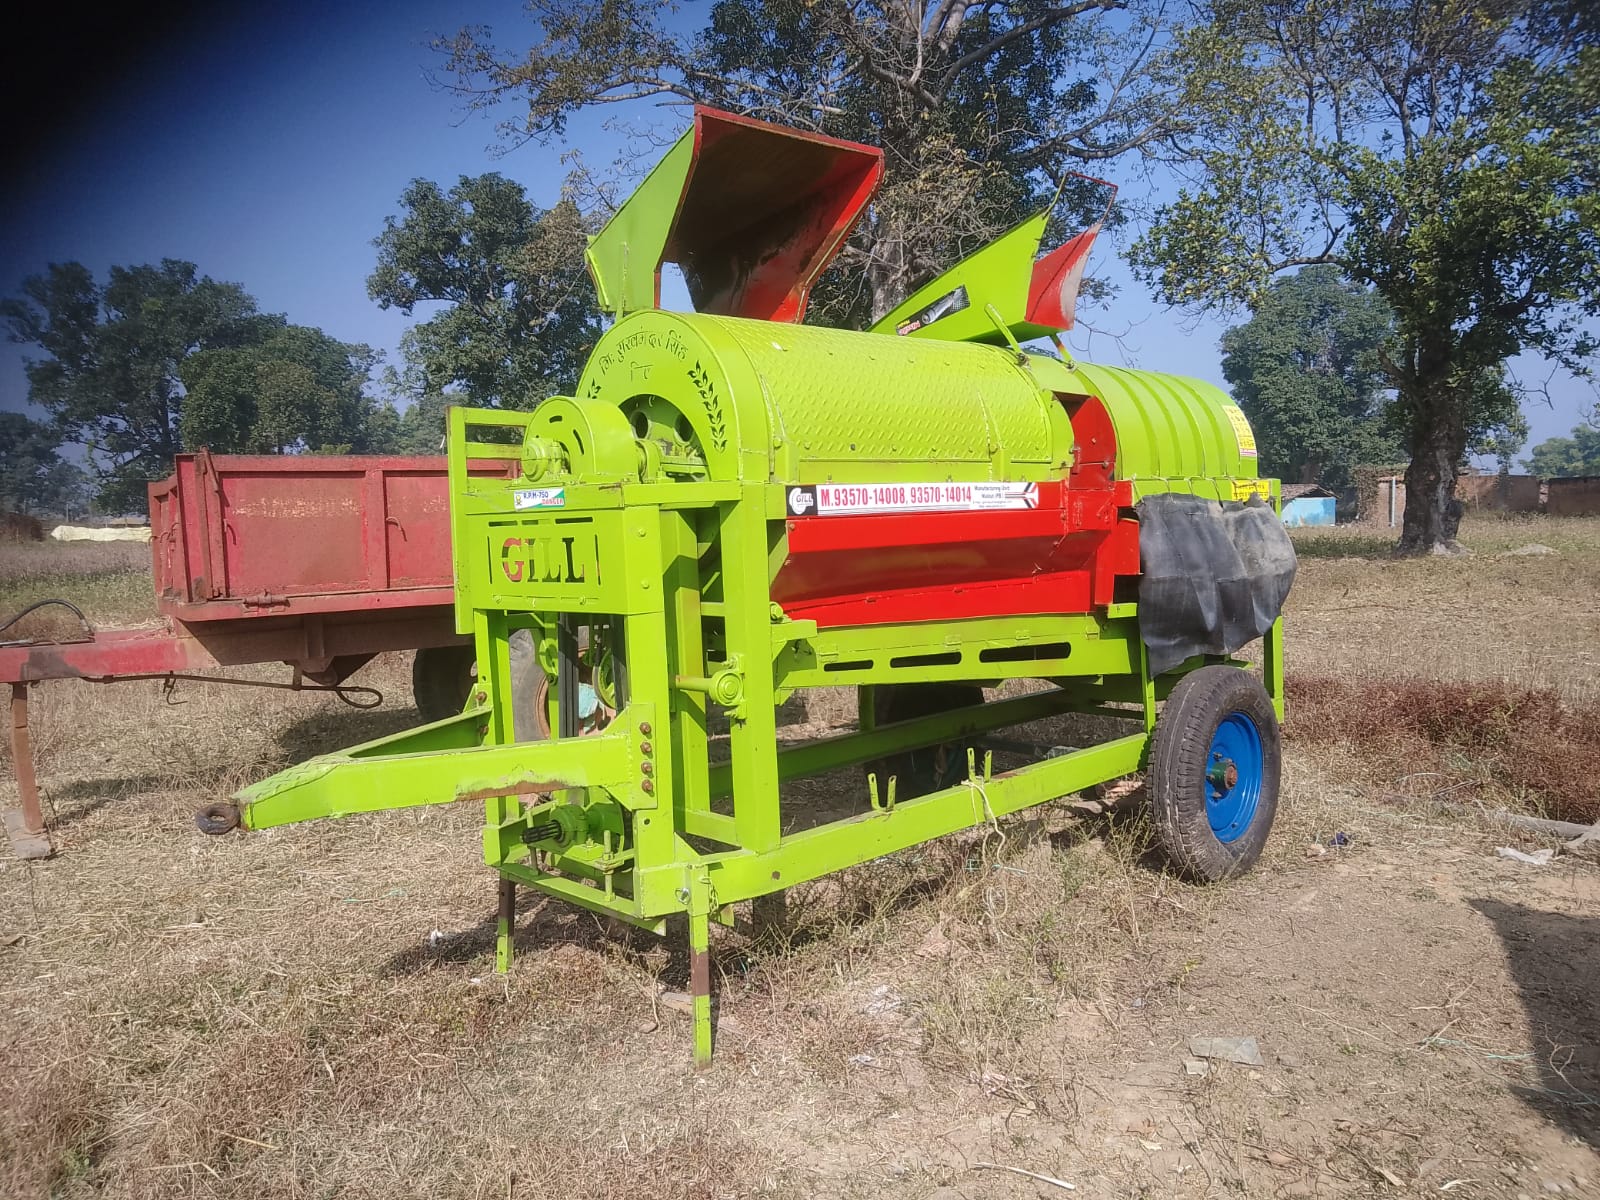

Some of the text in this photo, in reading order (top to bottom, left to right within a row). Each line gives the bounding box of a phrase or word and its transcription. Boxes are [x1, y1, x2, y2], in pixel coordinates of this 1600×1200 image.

[796, 494, 813, 503] GILL
[910, 486, 972, 504] 93570-14014
[501, 537, 585, 583] GILL
